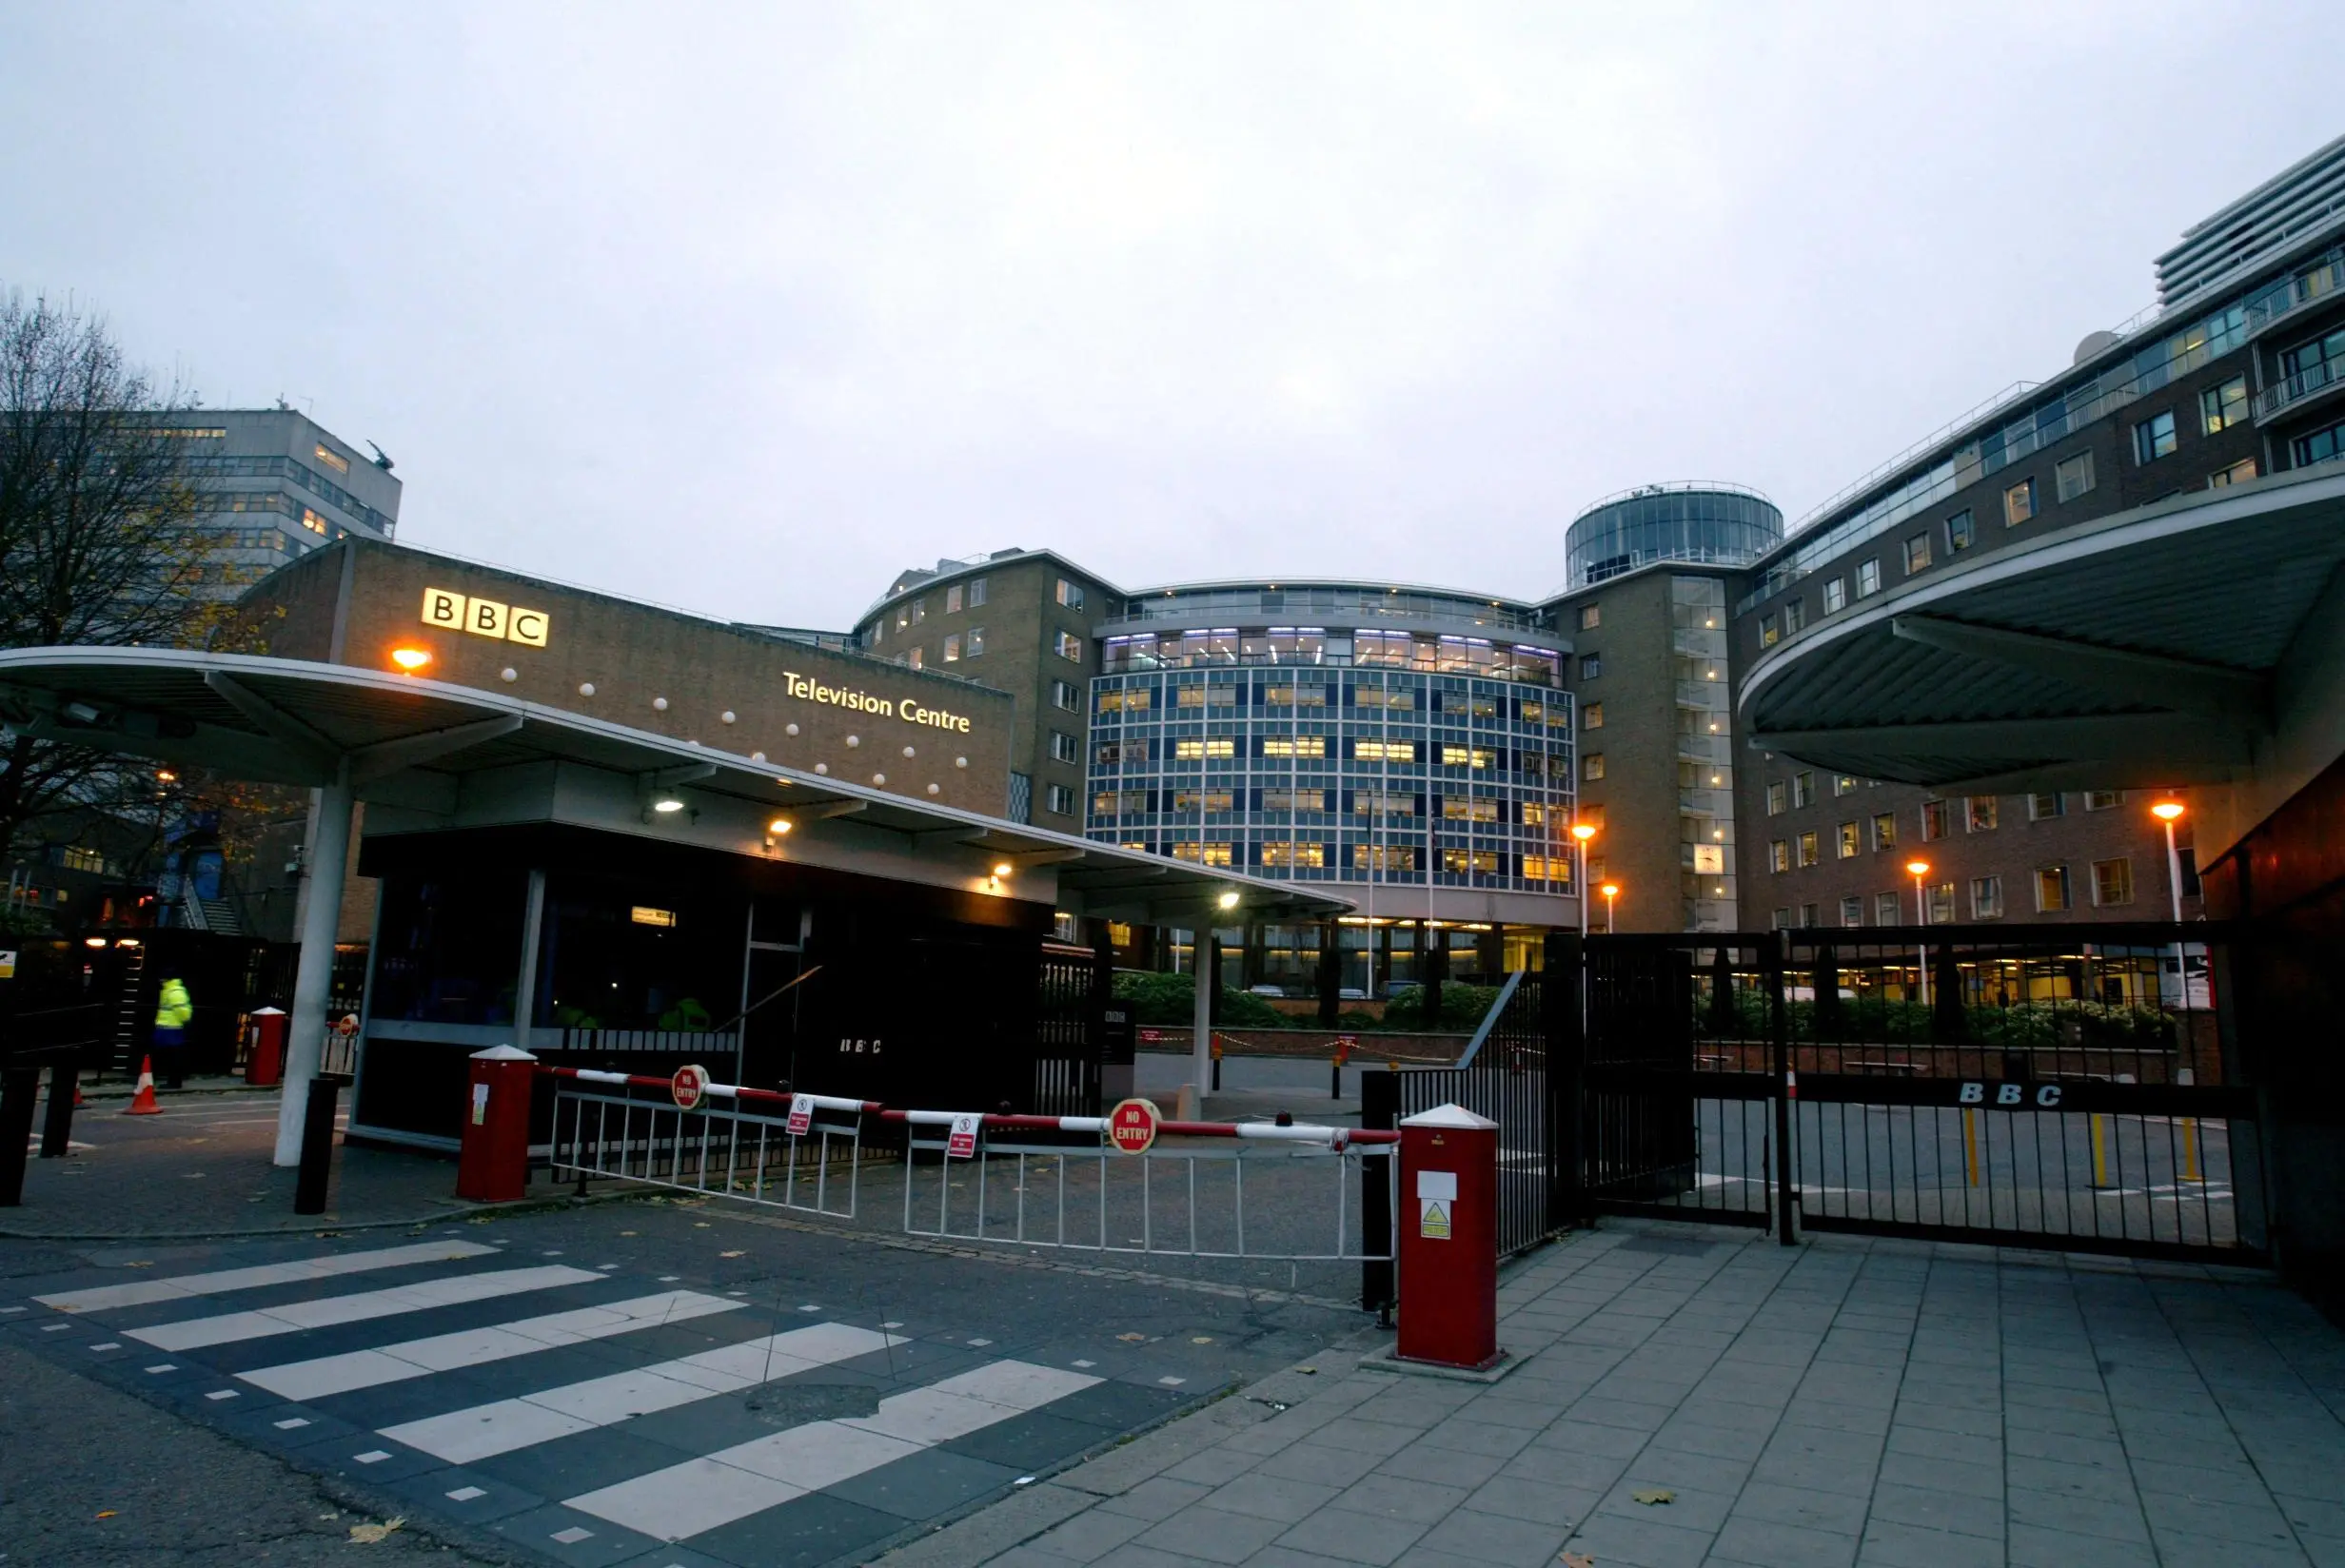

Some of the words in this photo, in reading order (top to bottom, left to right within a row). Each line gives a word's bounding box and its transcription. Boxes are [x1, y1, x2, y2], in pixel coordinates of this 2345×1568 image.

[433, 595, 542, 640] BBC
[783, 672, 892, 716] Television
[899, 699, 970, 733] Centre
[1960, 1083, 2061, 1107] BBC
[1126, 1110, 1140, 1124] NO
[1116, 1127, 1150, 1141] ENTRY
